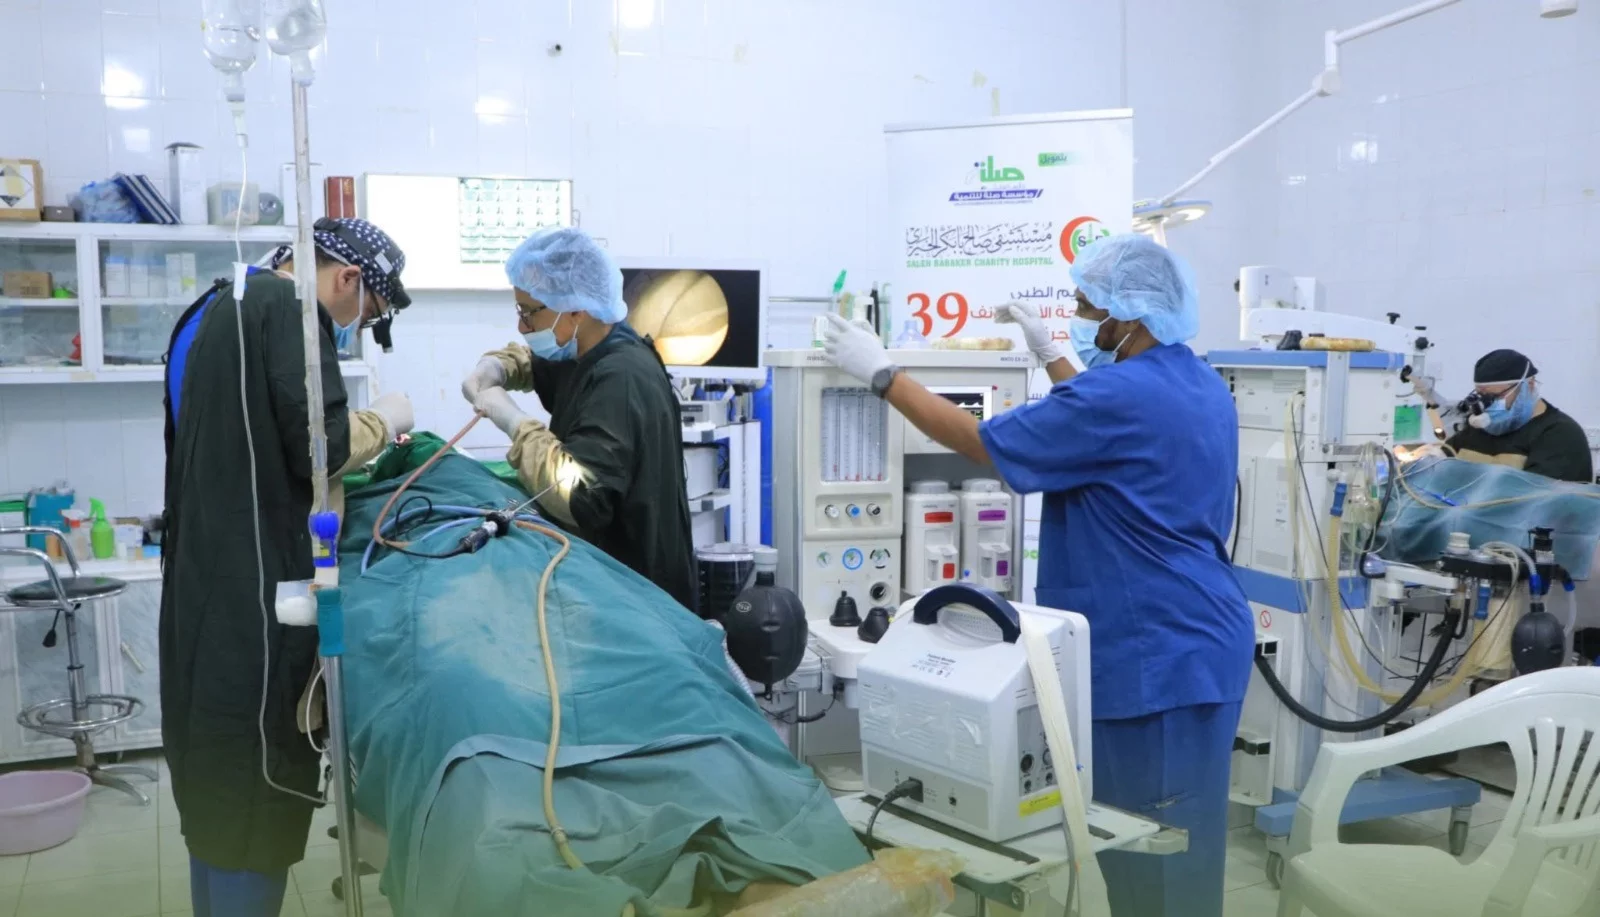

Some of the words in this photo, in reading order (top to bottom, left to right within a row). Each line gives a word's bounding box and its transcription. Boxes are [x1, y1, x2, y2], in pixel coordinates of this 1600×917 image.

[906, 259, 931, 268] SALEH
[974, 257, 1010, 267] CHARITY
[1012, 256, 1053, 266] HOSPITAL
[1010, 286, 1053, 301] الطبي
[907, 291, 969, 338] 39
